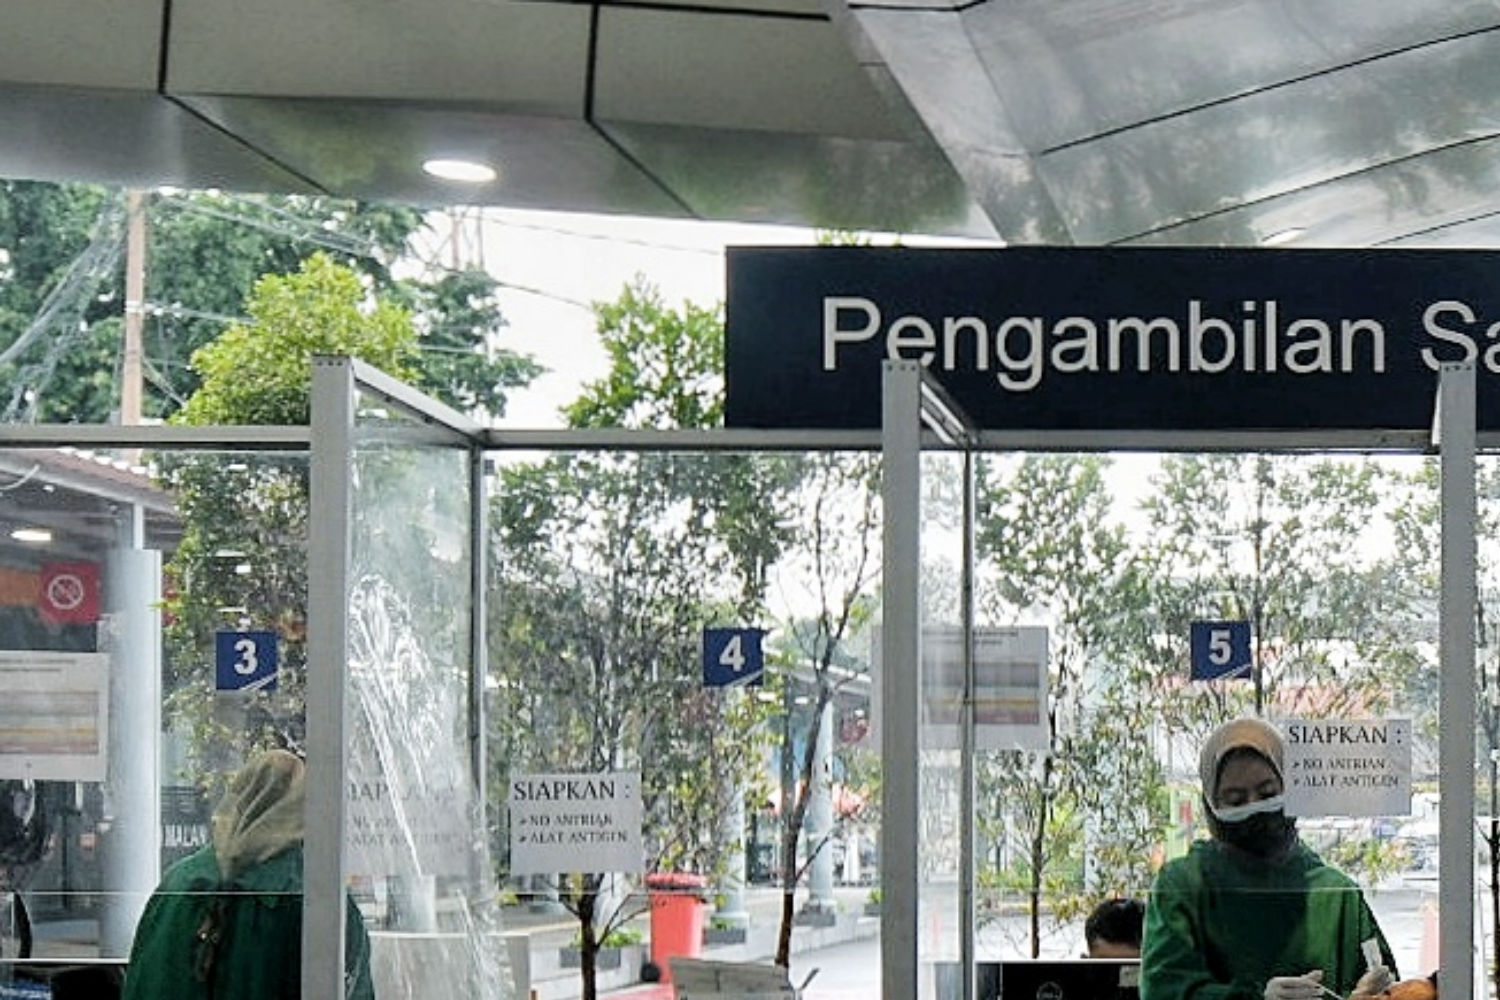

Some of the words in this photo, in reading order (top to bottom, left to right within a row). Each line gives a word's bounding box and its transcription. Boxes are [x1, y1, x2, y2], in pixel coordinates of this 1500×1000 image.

[822, 296, 1386, 392] Pengambilan
[234, 638, 258, 675] 3
[719, 634, 745, 673] 4
[1209, 629, 1231, 665] 5
[1288, 725, 1388, 744] SIAPKAN
[513, 780, 615, 801] SIAPKAN
